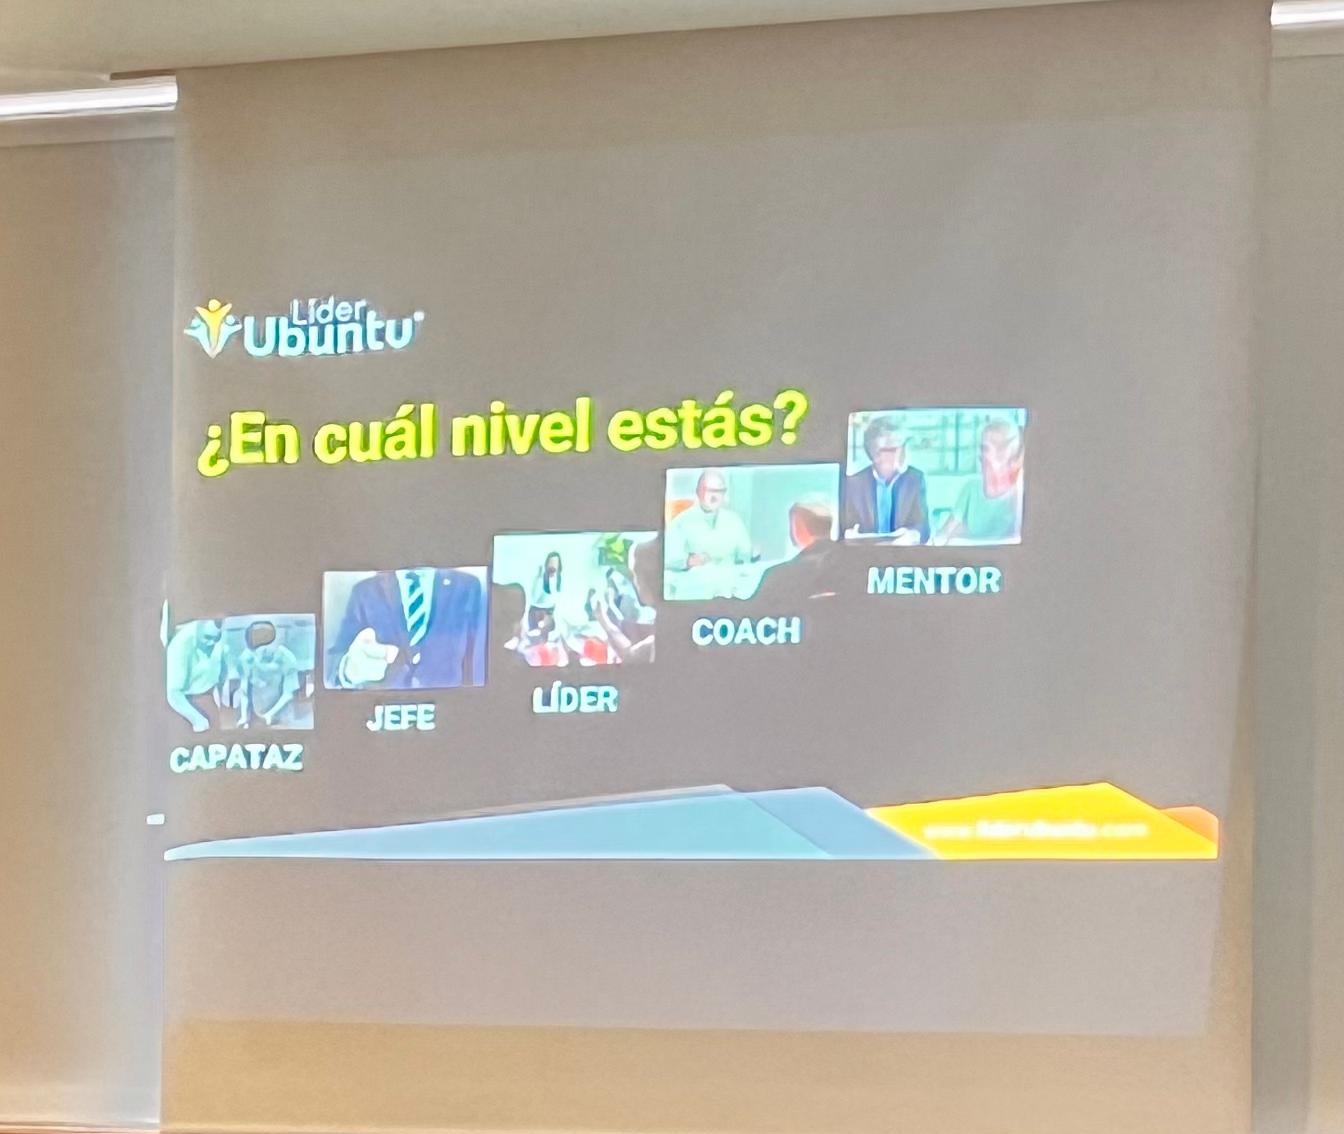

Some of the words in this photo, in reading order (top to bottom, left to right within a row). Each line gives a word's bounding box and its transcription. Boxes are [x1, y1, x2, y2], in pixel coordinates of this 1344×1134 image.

[243, 310, 413, 358] Ubuntu
[197, 410, 300, 477] ¿En
[314, 402, 436, 465] cuál
[451, 396, 592, 457] nivel
[607, 389, 808, 452] estás?
[866, 566, 1002, 595] MENTOR
[691, 616, 801, 646] COACH
[531, 680, 619, 714] LÍDER
[365, 703, 436, 732] JEFE
[169, 743, 304, 774] CAPATAZ
